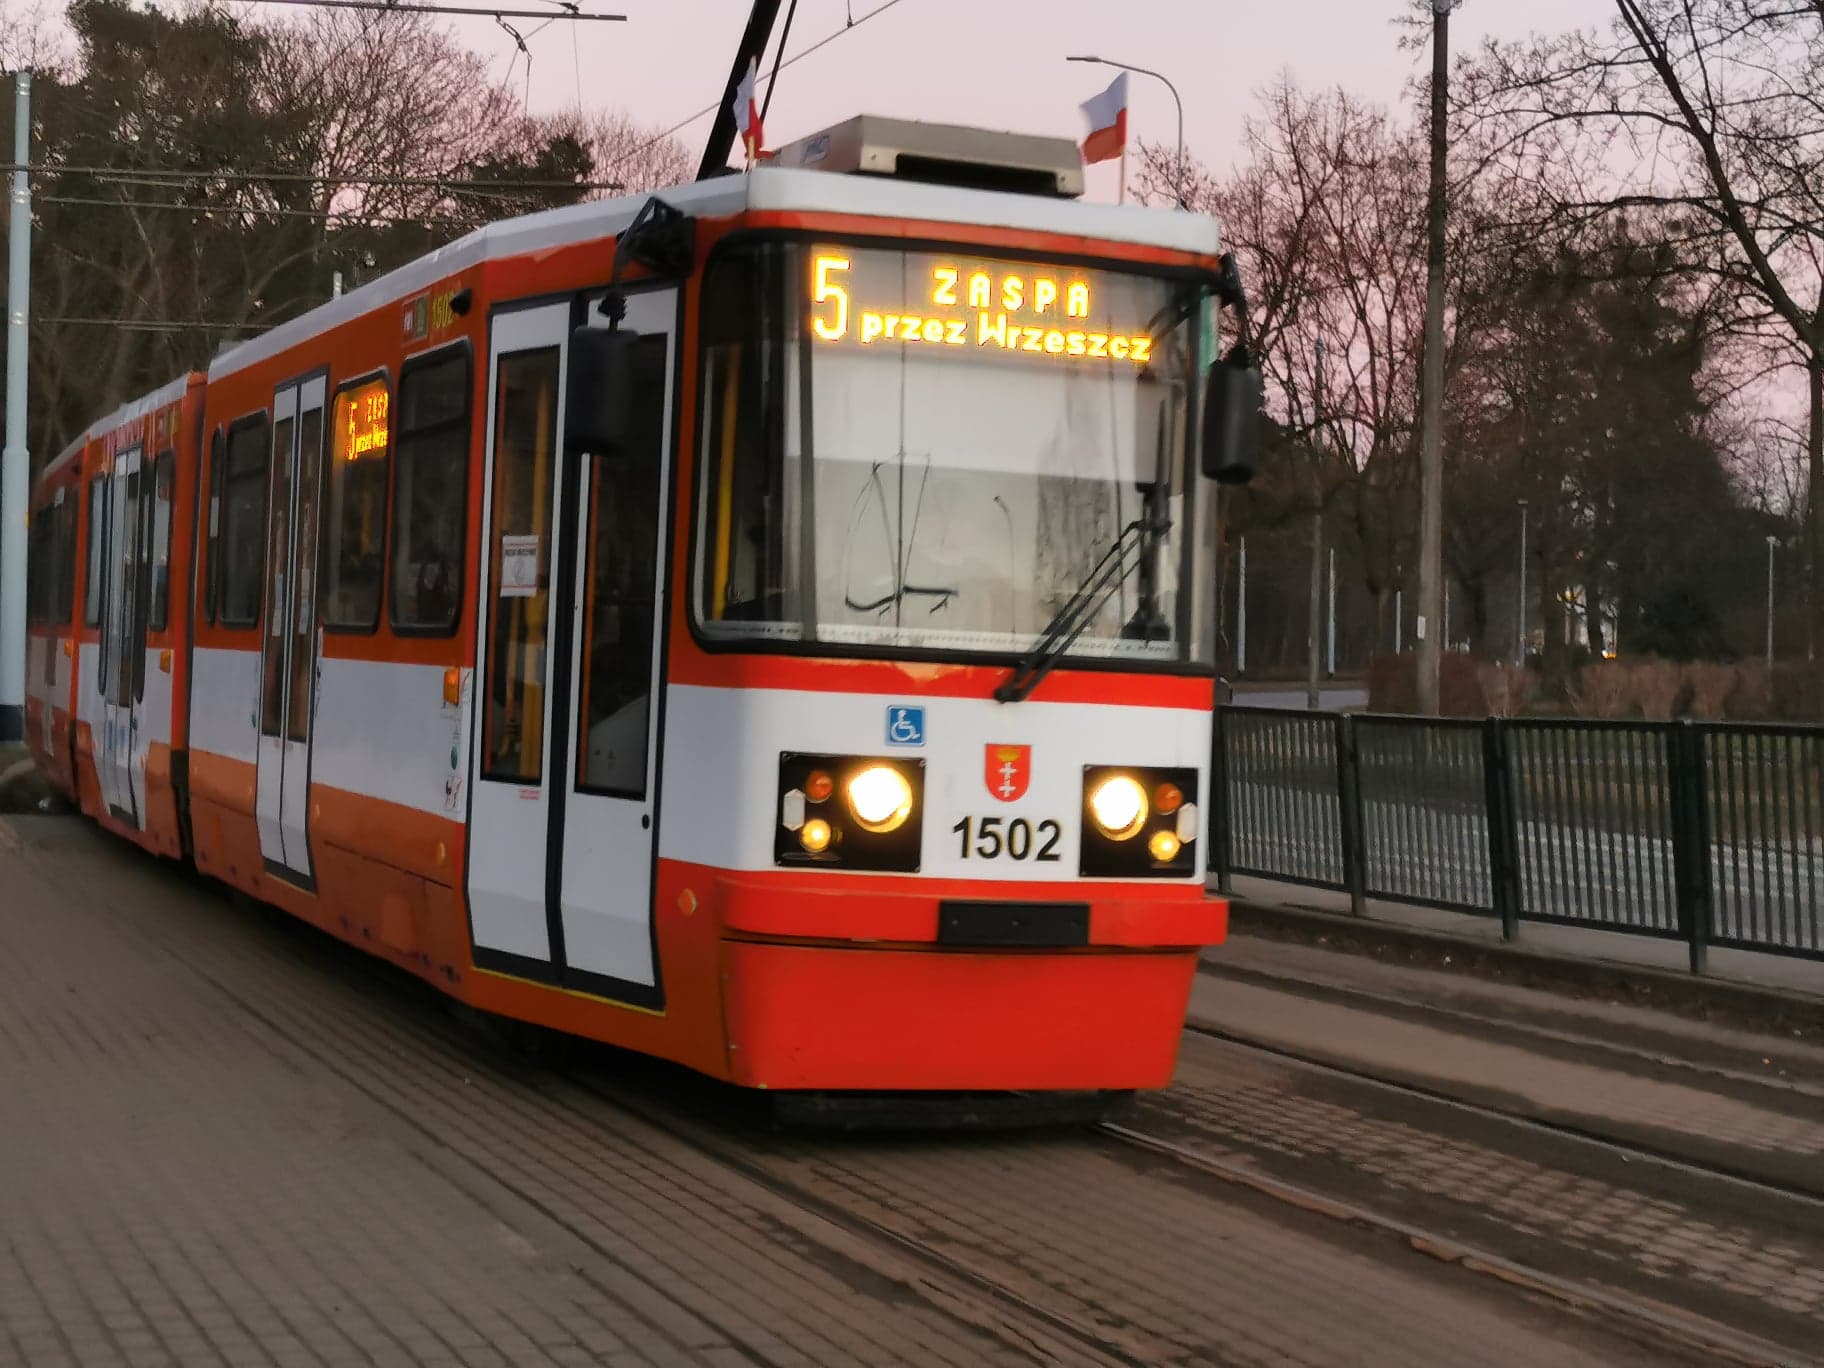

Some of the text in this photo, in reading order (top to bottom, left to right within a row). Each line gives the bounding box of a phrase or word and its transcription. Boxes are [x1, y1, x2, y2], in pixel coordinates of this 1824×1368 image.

[813, 256, 850, 341] 5
[932, 268, 1090, 318] ZASPA
[859, 311, 1152, 362] przez Wrzeszcz
[952, 815, 1062, 862] 1502
